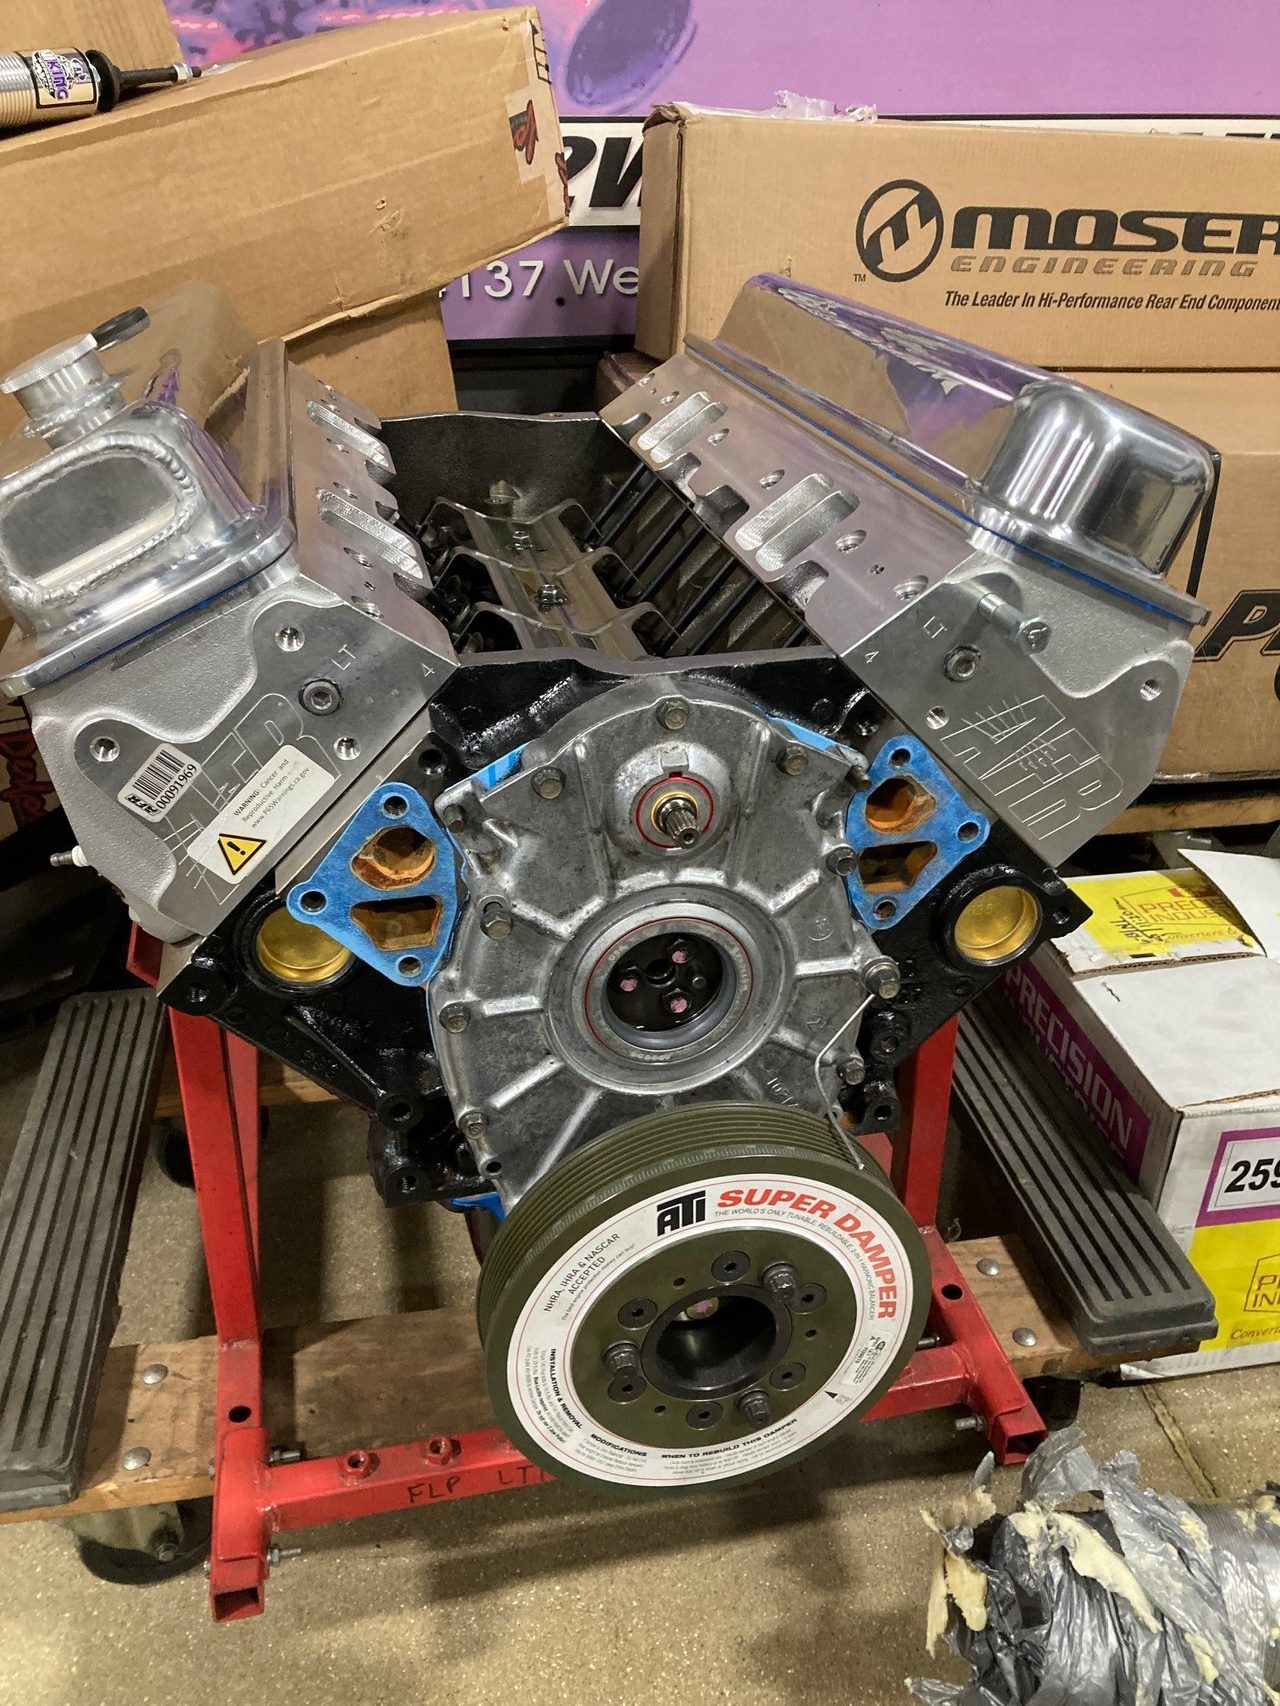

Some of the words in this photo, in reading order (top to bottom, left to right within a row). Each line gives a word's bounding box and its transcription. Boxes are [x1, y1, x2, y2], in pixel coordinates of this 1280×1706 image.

[951, 206, 1280, 255] MOSER
[438, 260, 544, 298] 137
[853, 274, 866, 282] TM
[950, 255, 1258, 277] ENGINEERING
[945, 290, 969, 307] The
[972, 291, 1019, 307] Leader
[1022, 292, 1035, 307] In
[1038, 293, 1144, 309] Hi-Performance
[1145, 294, 1179, 310] Rear
[1179, 294, 1207, 310] End
[155, 763, 197, 810] 00091969
[260, 771, 279, 789] Cancer
[242, 789, 275, 823] Reproductive
[715, 1209, 730, 1217] THE
[767, 1208, 786, 1216] ONLY
[544, 1289, 565, 1312] NHRA,
[560, 1268, 580, 1288] IHRA
[584, 1233, 621, 1262] NASCAR
[717, 1189, 837, 1219] SUPER
[834, 1213, 897, 1320] DAMPER
[568, 1256, 605, 1295] ACCEPTED
[550, 1348, 560, 1397] INSTALLATION
[560, 1403, 583, 1429] REMOVAL
[591, 1433, 648, 1457] MODIFICATIONS
[702, 1444, 740, 1456] REBUILD
[742, 1436, 762, 1447] THIS
[763, 1418, 798, 1438] DAMPER
[406, 1476, 461, 1503] FLP
